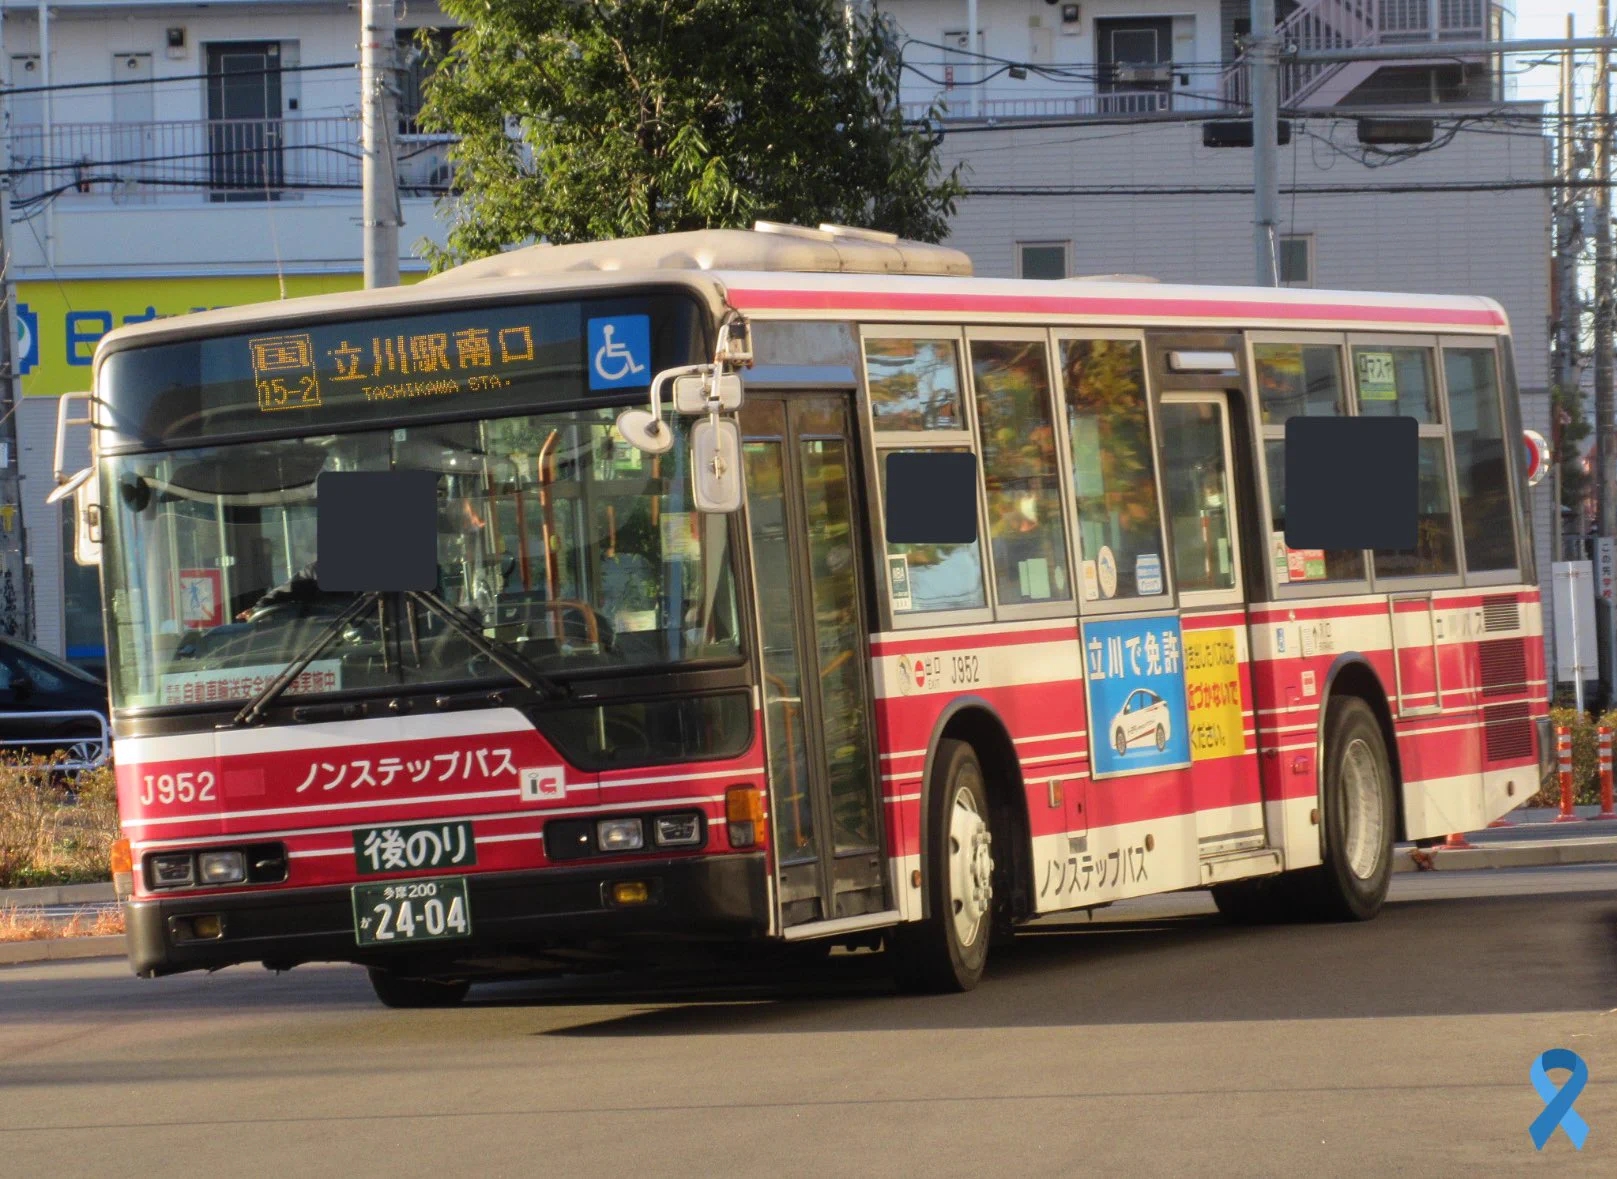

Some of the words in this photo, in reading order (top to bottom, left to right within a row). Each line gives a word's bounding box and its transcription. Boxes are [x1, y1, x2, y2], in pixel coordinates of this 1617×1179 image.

[327, 326, 534, 382] 立川駅南口
[259, 375, 316, 406] 15-2
[361, 379, 459, 400] TACHIKAWA
[467, 375, 512, 392] STA.
[951, 655, 980, 685] J952
[1088, 631, 1179, 680] 立川で免許
[140, 770, 216, 805] J952
[297, 748, 519, 792] ノンステップバス
[363, 825, 466, 870] 後のり
[1041, 846, 1148, 898] ノンステップバス
[373, 896, 467, 940] 24-04
